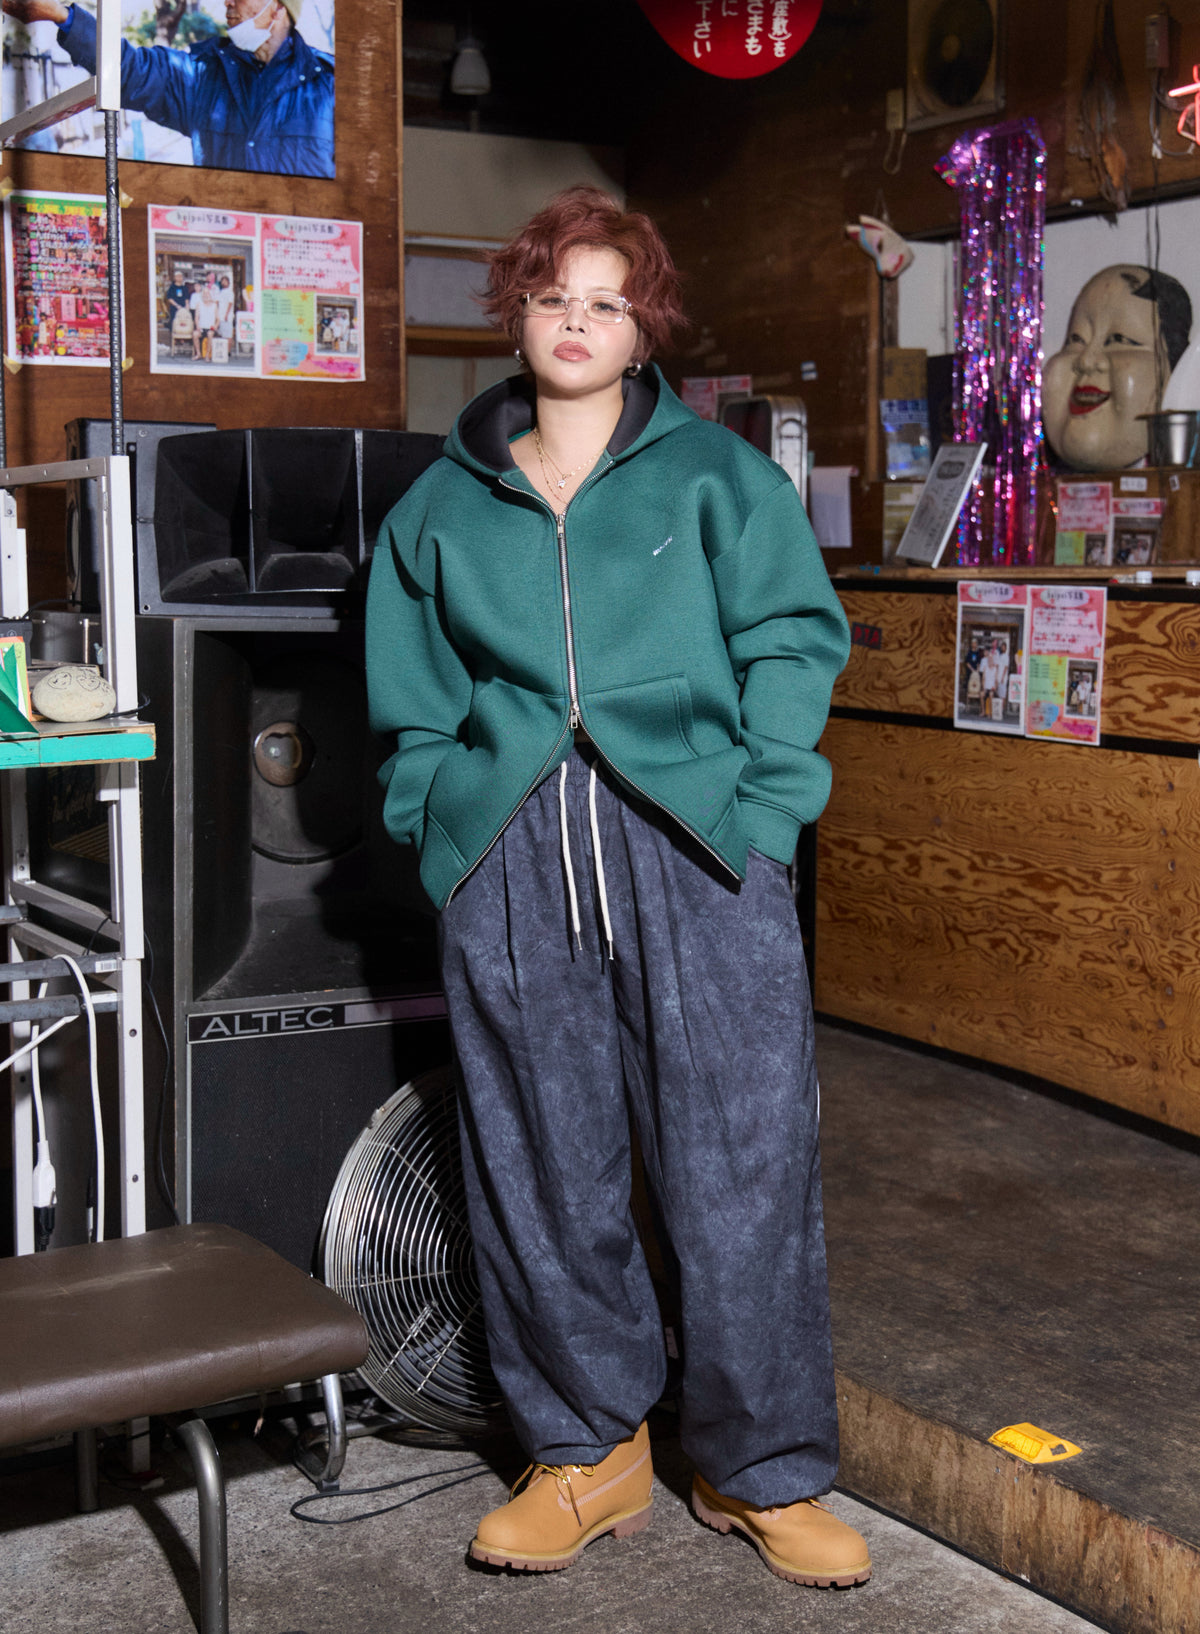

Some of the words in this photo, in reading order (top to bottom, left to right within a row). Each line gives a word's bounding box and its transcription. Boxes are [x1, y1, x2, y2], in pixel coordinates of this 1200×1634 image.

[693, 0, 712, 58] 下さい
[200, 1006, 334, 1038] ALTEC
